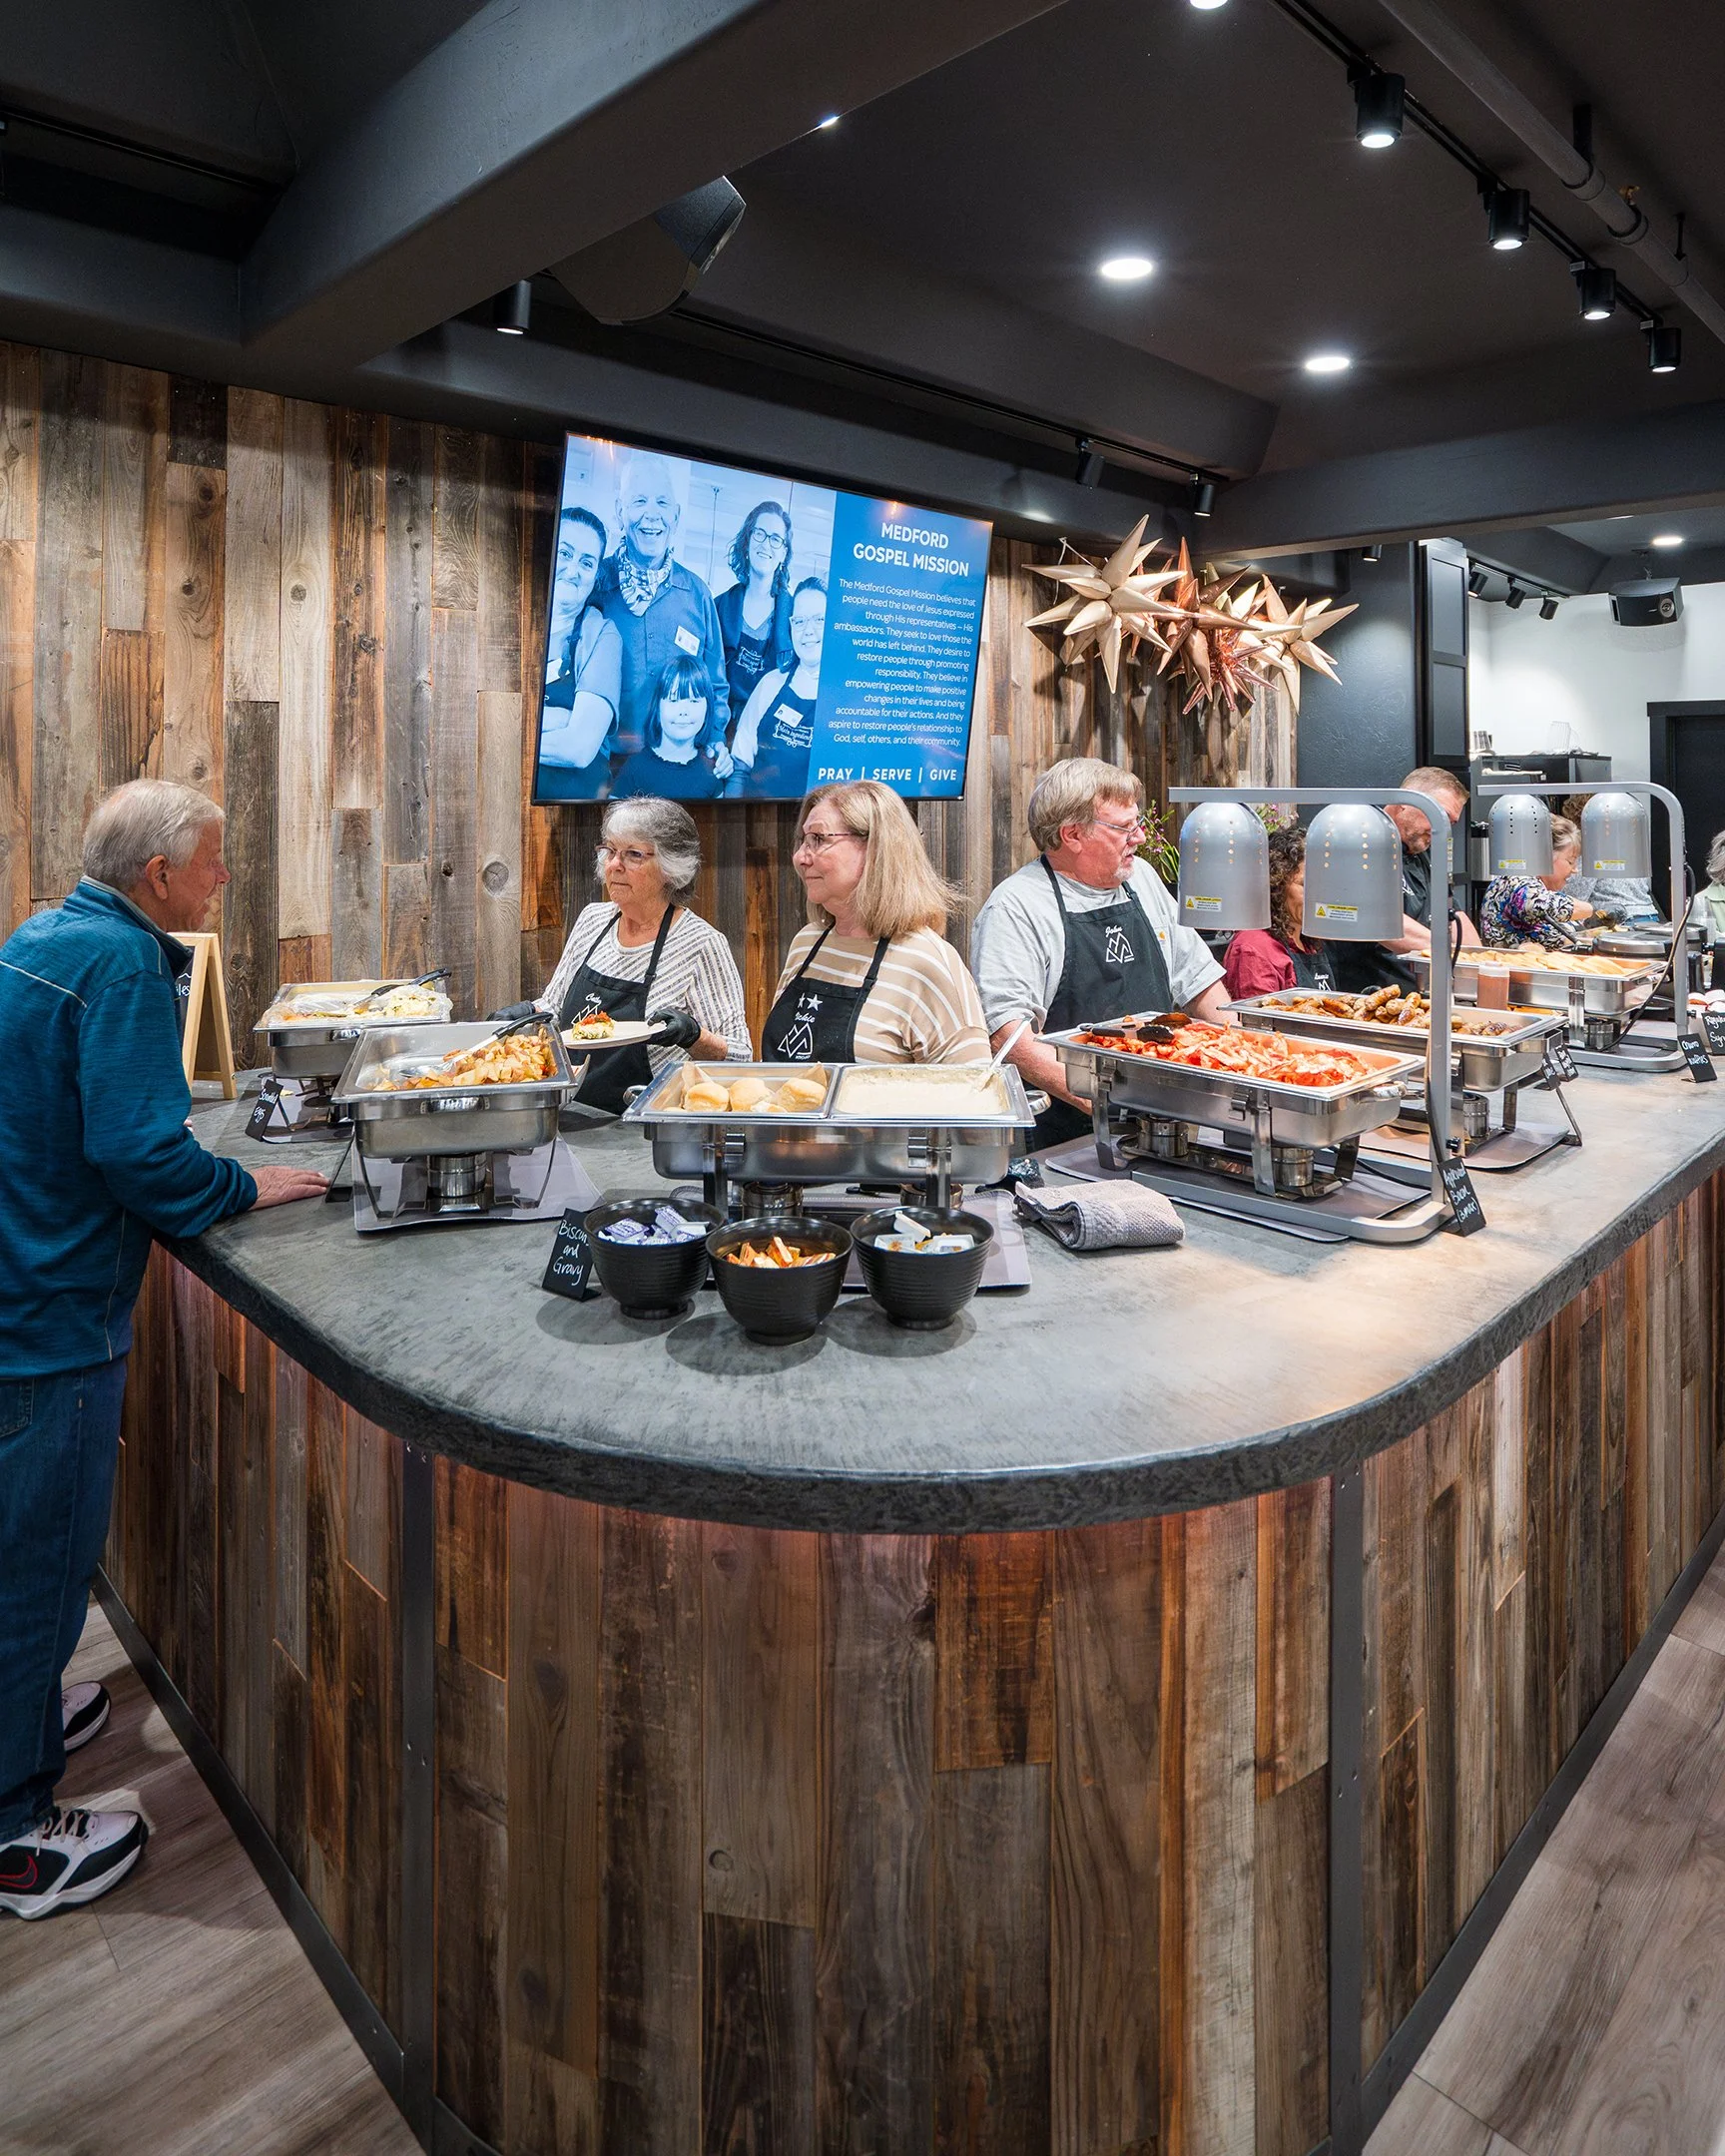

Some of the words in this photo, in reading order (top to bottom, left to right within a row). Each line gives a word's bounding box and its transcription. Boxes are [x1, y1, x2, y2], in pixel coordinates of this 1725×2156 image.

[880, 522, 949, 549] MEDFORD
[853, 542, 910, 568] GOSPEL
[912, 553, 969, 577] MISSION
[840, 578, 854, 589] The
[854, 581, 885, 593] Medford
[885, 585, 910, 598] Gospel
[910, 589, 936, 601] Mission
[936, 593, 962, 605] believes
[962, 598, 976, 608] that
[842, 594, 869, 606] people
[868, 598, 888, 608] need
[888, 600, 901, 610] the
[901, 602, 916, 611] love
[916, 604, 924, 613] of
[924, 605, 942, 615] Jesus
[942, 607, 975, 620] expressed
[864, 610, 894, 624] through
[894, 614, 906, 624] His
[906, 617, 957, 631] representatives
[962, 623, 974, 633] His
[834, 622, 885, 635] ambassadors.
[885, 626, 903, 639] They
[903, 630, 919, 639] seek
[919, 631, 928, 640] to
[927, 631, 942, 642] love
[941, 633, 961, 644] those
[960, 636, 972, 645] the
[852, 638, 874, 648] world
[873, 639, 887, 649] has
[887, 641, 900, 651] left
[900, 642, 926, 653] behind.
[926, 644, 943, 657] They
[942, 647, 963, 657] desire
[962, 649, 971, 658] to
[857, 653, 883, 663] restore
[882, 655, 908, 666] people
[908, 656, 936, 670] through
[935, 660, 970, 673] promoting
[874, 668, 922, 681] responsibility.
[922, 670, 939, 683] They
[938, 673, 961, 683] believe
[960, 674, 968, 684] in
[845, 680, 890, 693] empowering
[889, 683, 915, 694] people
[915, 684, 923, 693] to
[922, 685, 942, 694] make
[941, 687, 967, 696] positive
[863, 694, 894, 706] changes
[893, 695, 901, 705] in
[901, 696, 918, 706] their
[918, 697, 934, 707] lives
[933, 698, 948, 708] and
[947, 699, 966, 711] being
[835, 707, 881, 717] accountable
[880, 708, 892, 718] for
[891, 709, 909, 719] their
[908, 710, 935, 720] actions.
[934, 711, 950, 721] And
[949, 712, 965, 723] they
[828, 720, 853, 730] aspire
[852, 721, 862, 730] to
[861, 722, 887, 731] restore
[916, 724, 955, 735] relationship
[954, 725, 963, 734] to
[833, 733, 852, 744] God,
[852, 734, 867, 745] self,
[866, 735, 892, 745] others,
[892, 736, 908, 745] and
[907, 737, 923, 746] their
[923, 738, 961, 748] community.
[818, 768, 854, 781] PRAY
[872, 769, 911, 781] SERVE
[929, 769, 957, 781] GIVE
[1105, 925, 1123, 938] John
[562, 1244, 580, 1259] and
[552, 1256, 584, 1287] Gravy
